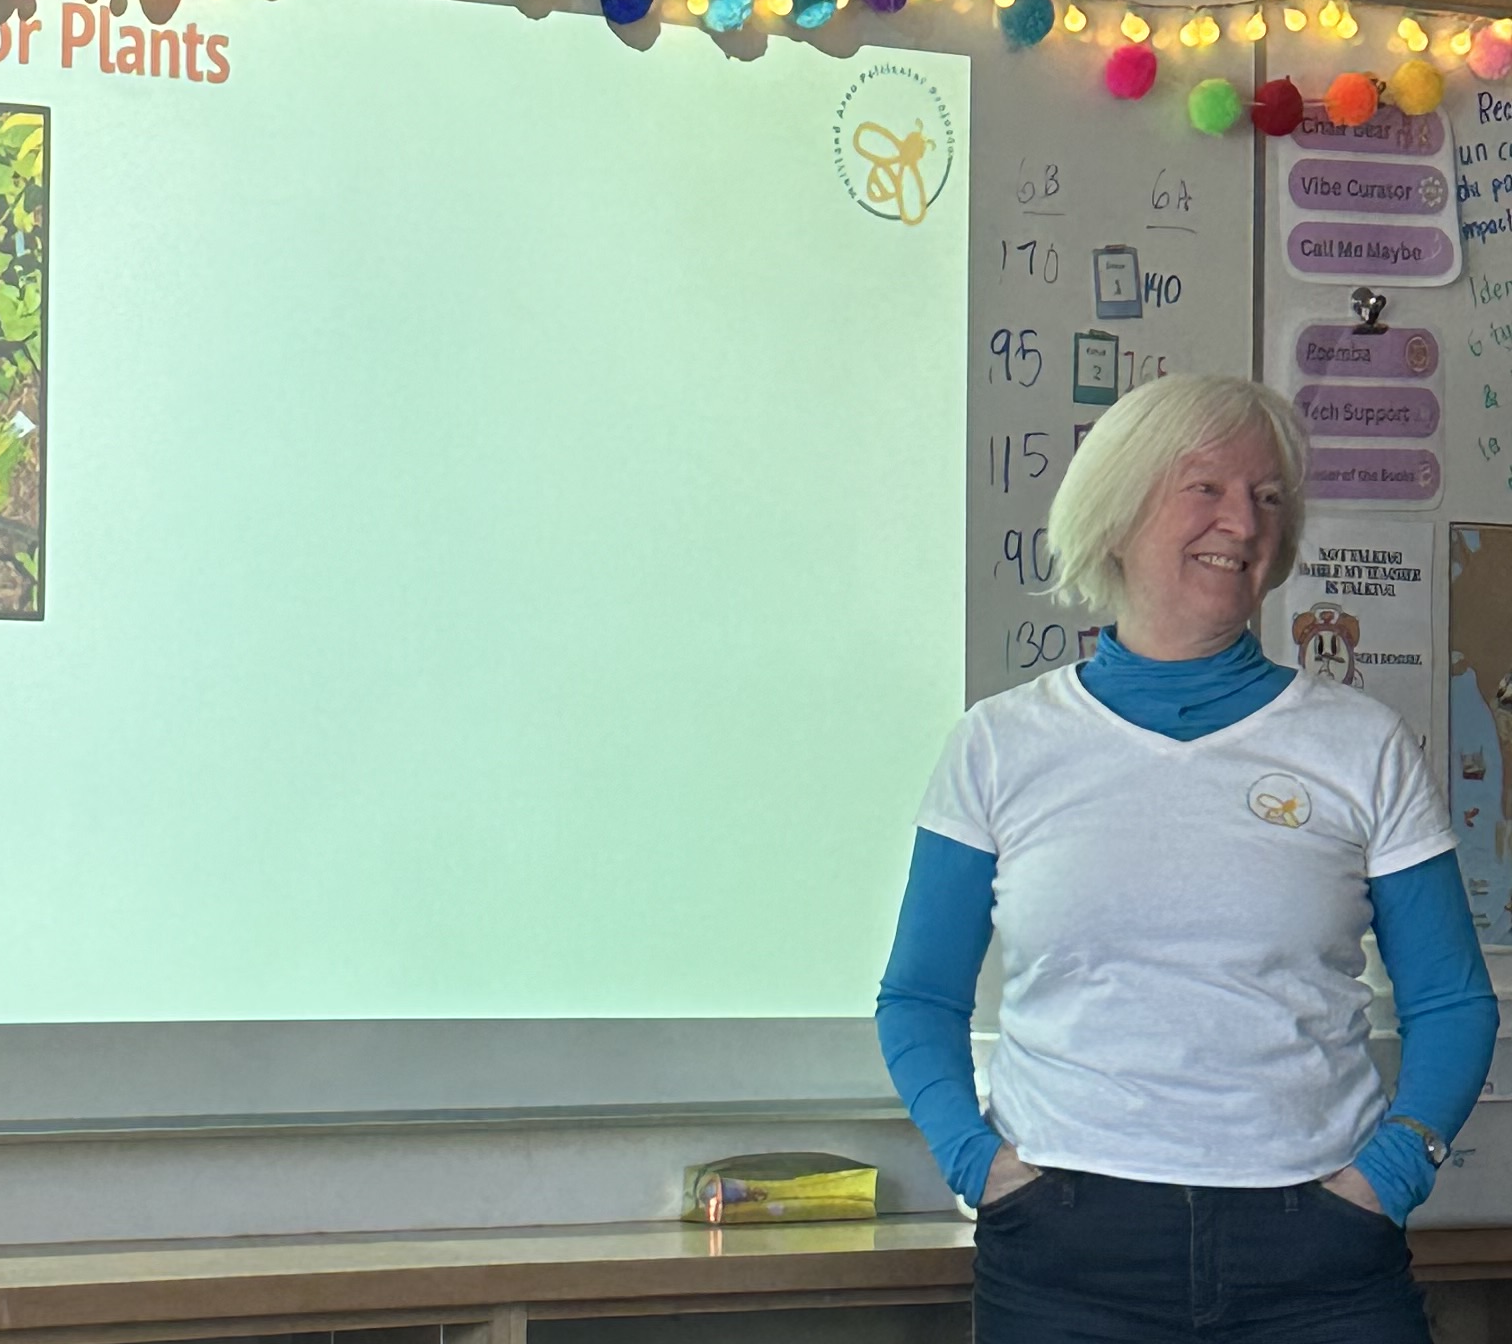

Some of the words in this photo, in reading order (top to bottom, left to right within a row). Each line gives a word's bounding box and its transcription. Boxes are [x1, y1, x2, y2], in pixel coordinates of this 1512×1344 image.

[61, 2, 232, 84] Plants
[1301, 176, 1342, 196] Vibe
[1344, 403, 1410, 426] Support
